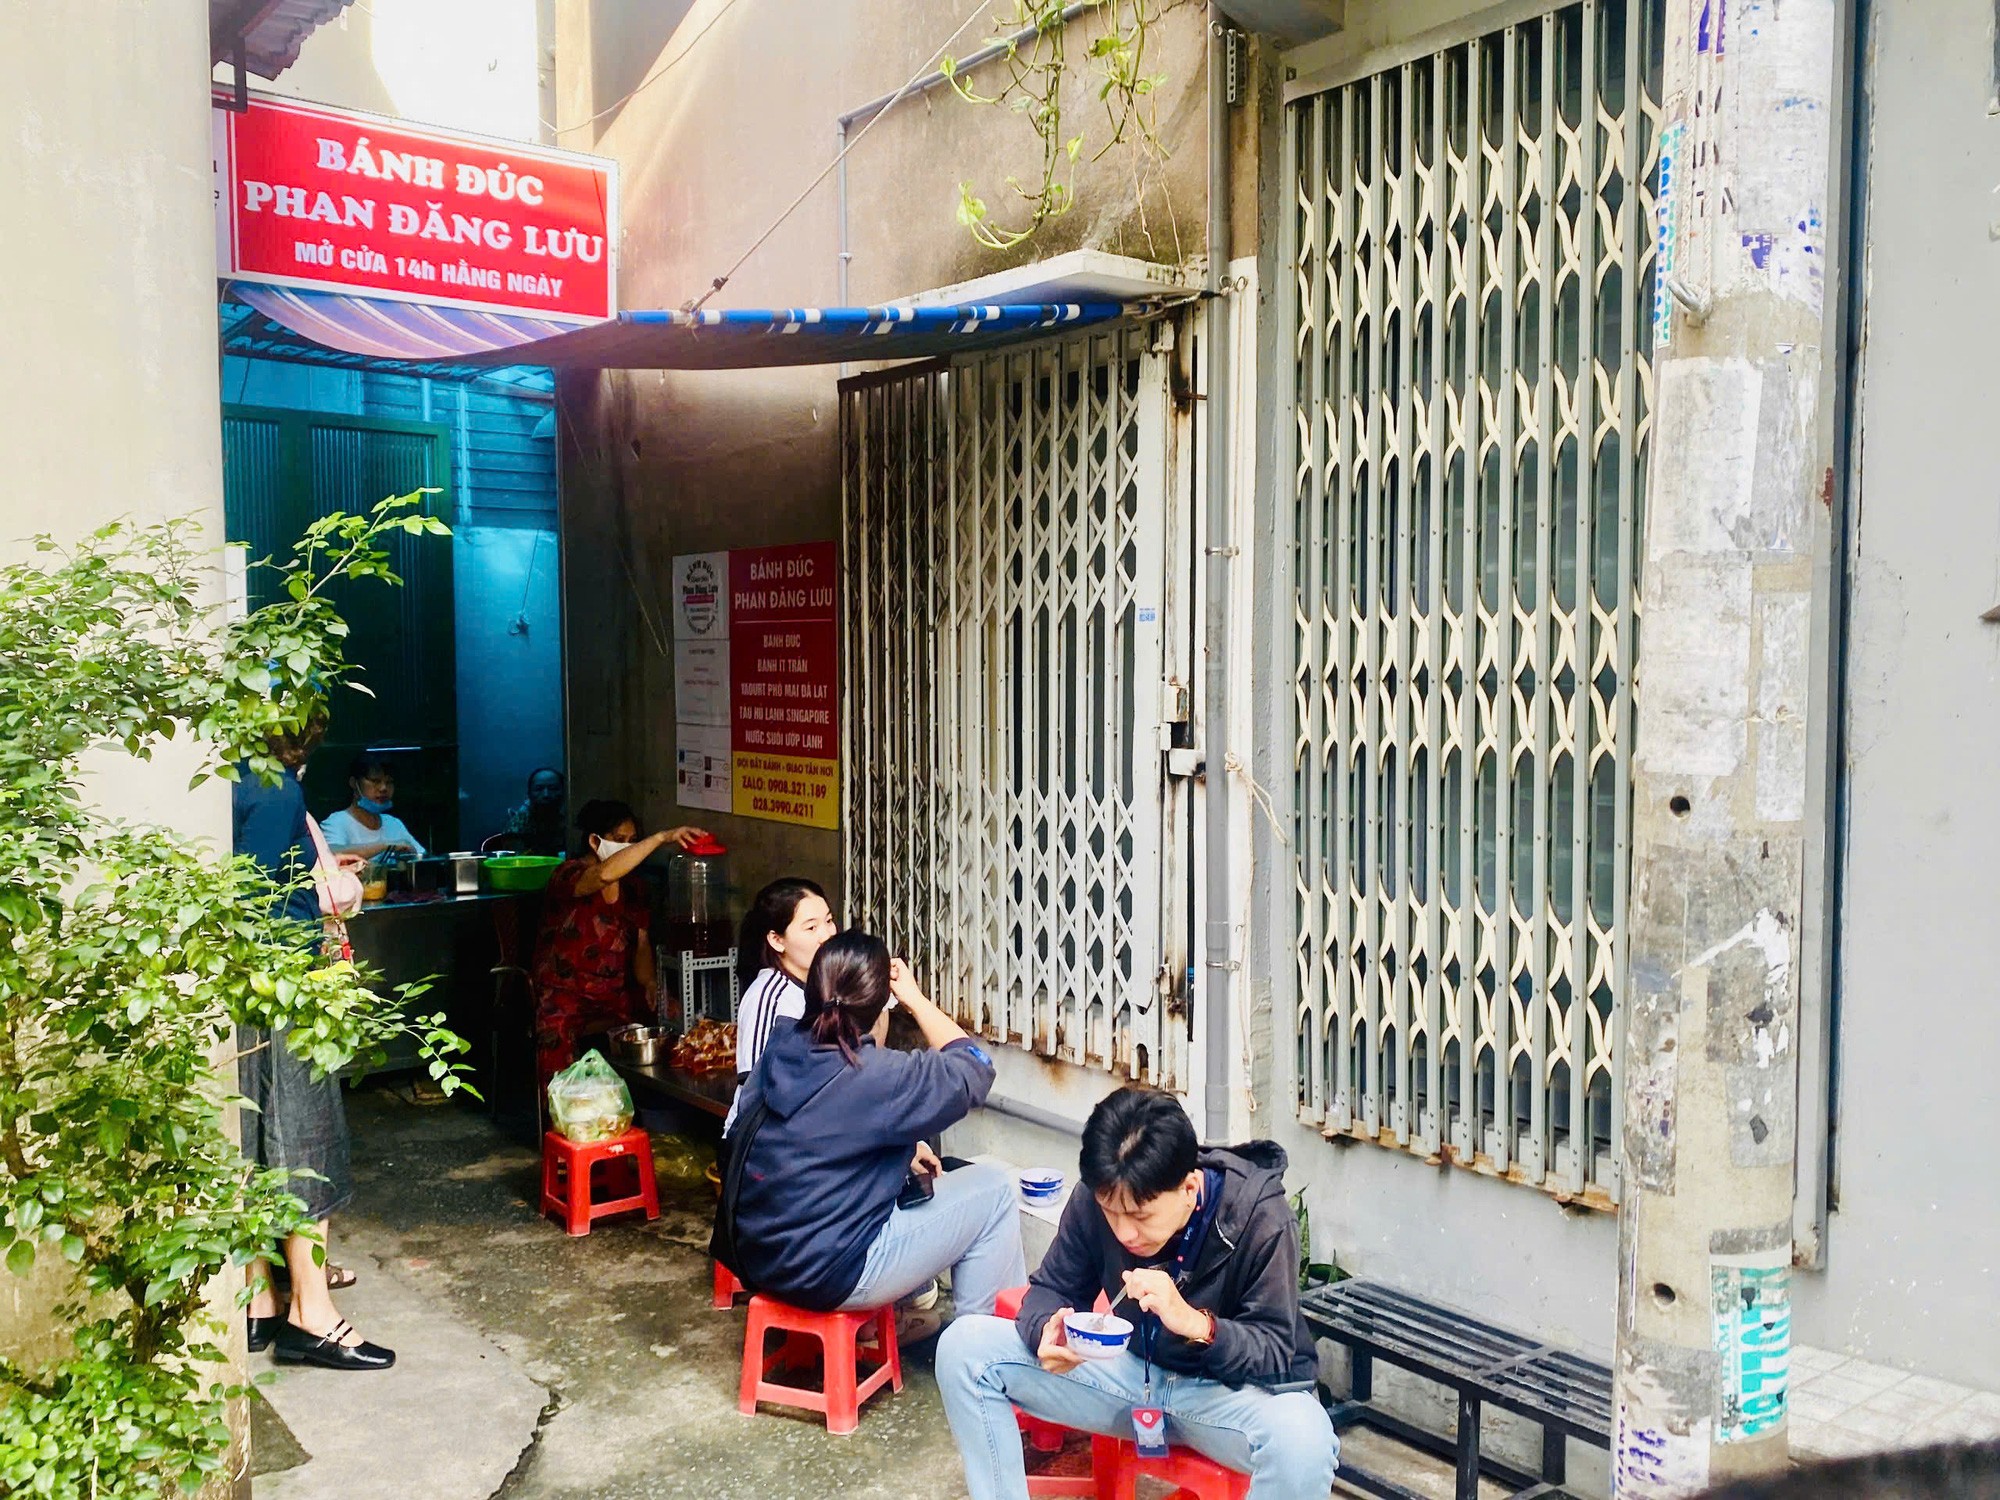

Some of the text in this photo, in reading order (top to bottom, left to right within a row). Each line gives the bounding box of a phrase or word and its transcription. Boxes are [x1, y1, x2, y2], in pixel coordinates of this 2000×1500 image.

[316, 137, 544, 206] BÁNH ĐÚC
[243, 180, 375, 230] PHAN
[388, 200, 512, 249] ĐĂNG
[523, 225, 603, 263] LƯU
[294, 238, 563, 298] MỞ CỬA 14h HẰNG NGÀY
[750, 554, 814, 580] BÁNH ĐÚC
[735, 591, 766, 610] PHAN
[769, 586, 806, 609] ĐĂNG
[810, 586, 833, 607] LƯU
[784, 683, 799, 698] MAI
[786, 708, 829, 724] SINGAPORE
[802, 734, 823, 751] LẠNH
[786, 762, 804, 774] GIAO
[742, 775, 827, 799] ZALO: 0908.321.189
[753, 796, 814, 819] 028.3990.4211
